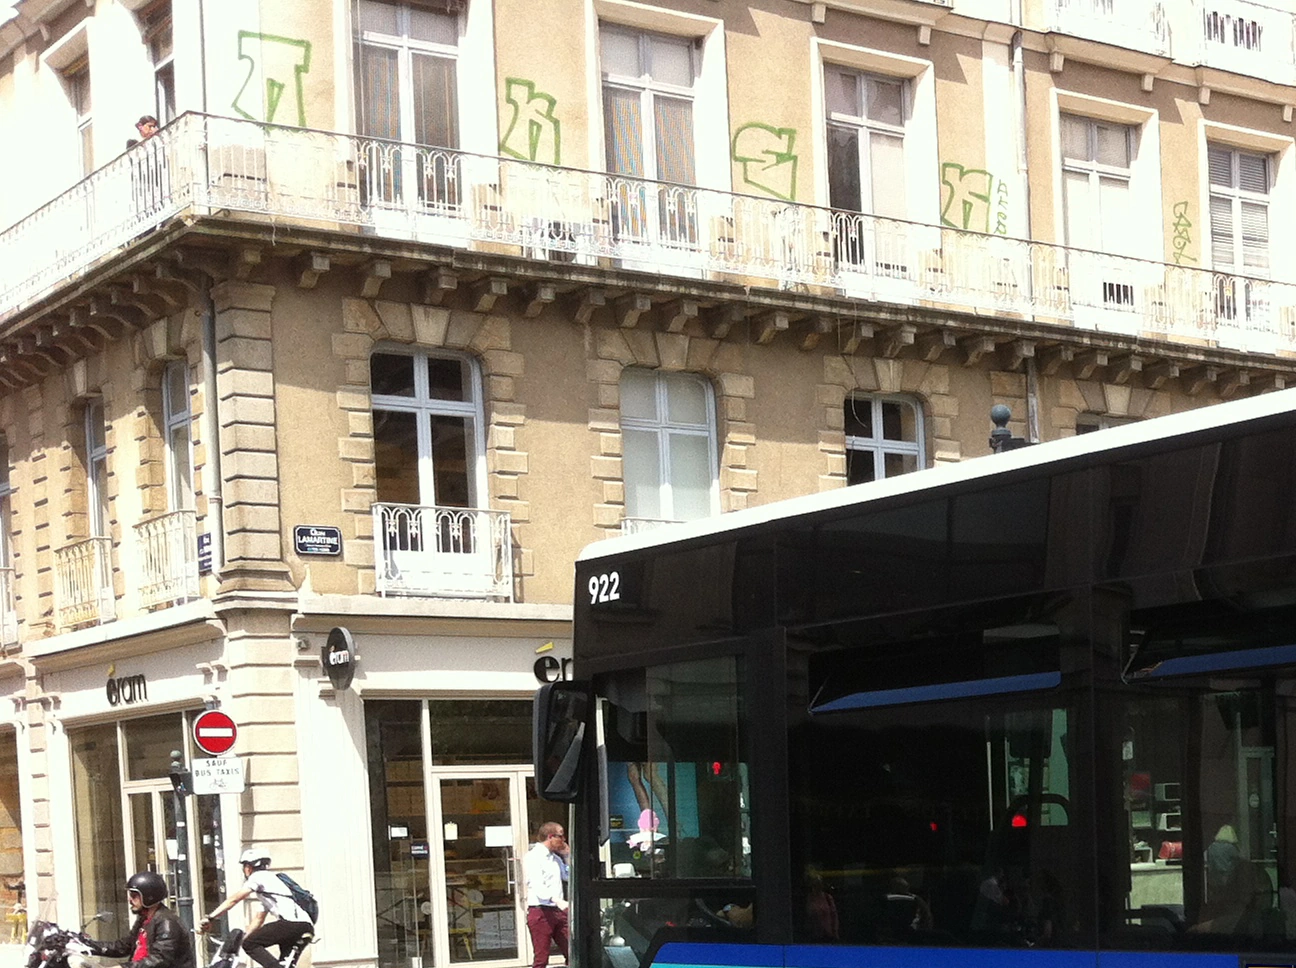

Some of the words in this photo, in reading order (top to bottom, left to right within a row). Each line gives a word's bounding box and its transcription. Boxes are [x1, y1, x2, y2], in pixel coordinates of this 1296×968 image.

[298, 535, 338, 544] LAMARTINE
[588, 571, 620, 605] 922
[533, 641, 574, 683] ér
[206, 759, 228, 767] SAUF
[194, 769, 212, 778] BUS
[217, 767, 240, 775] TAXIS
